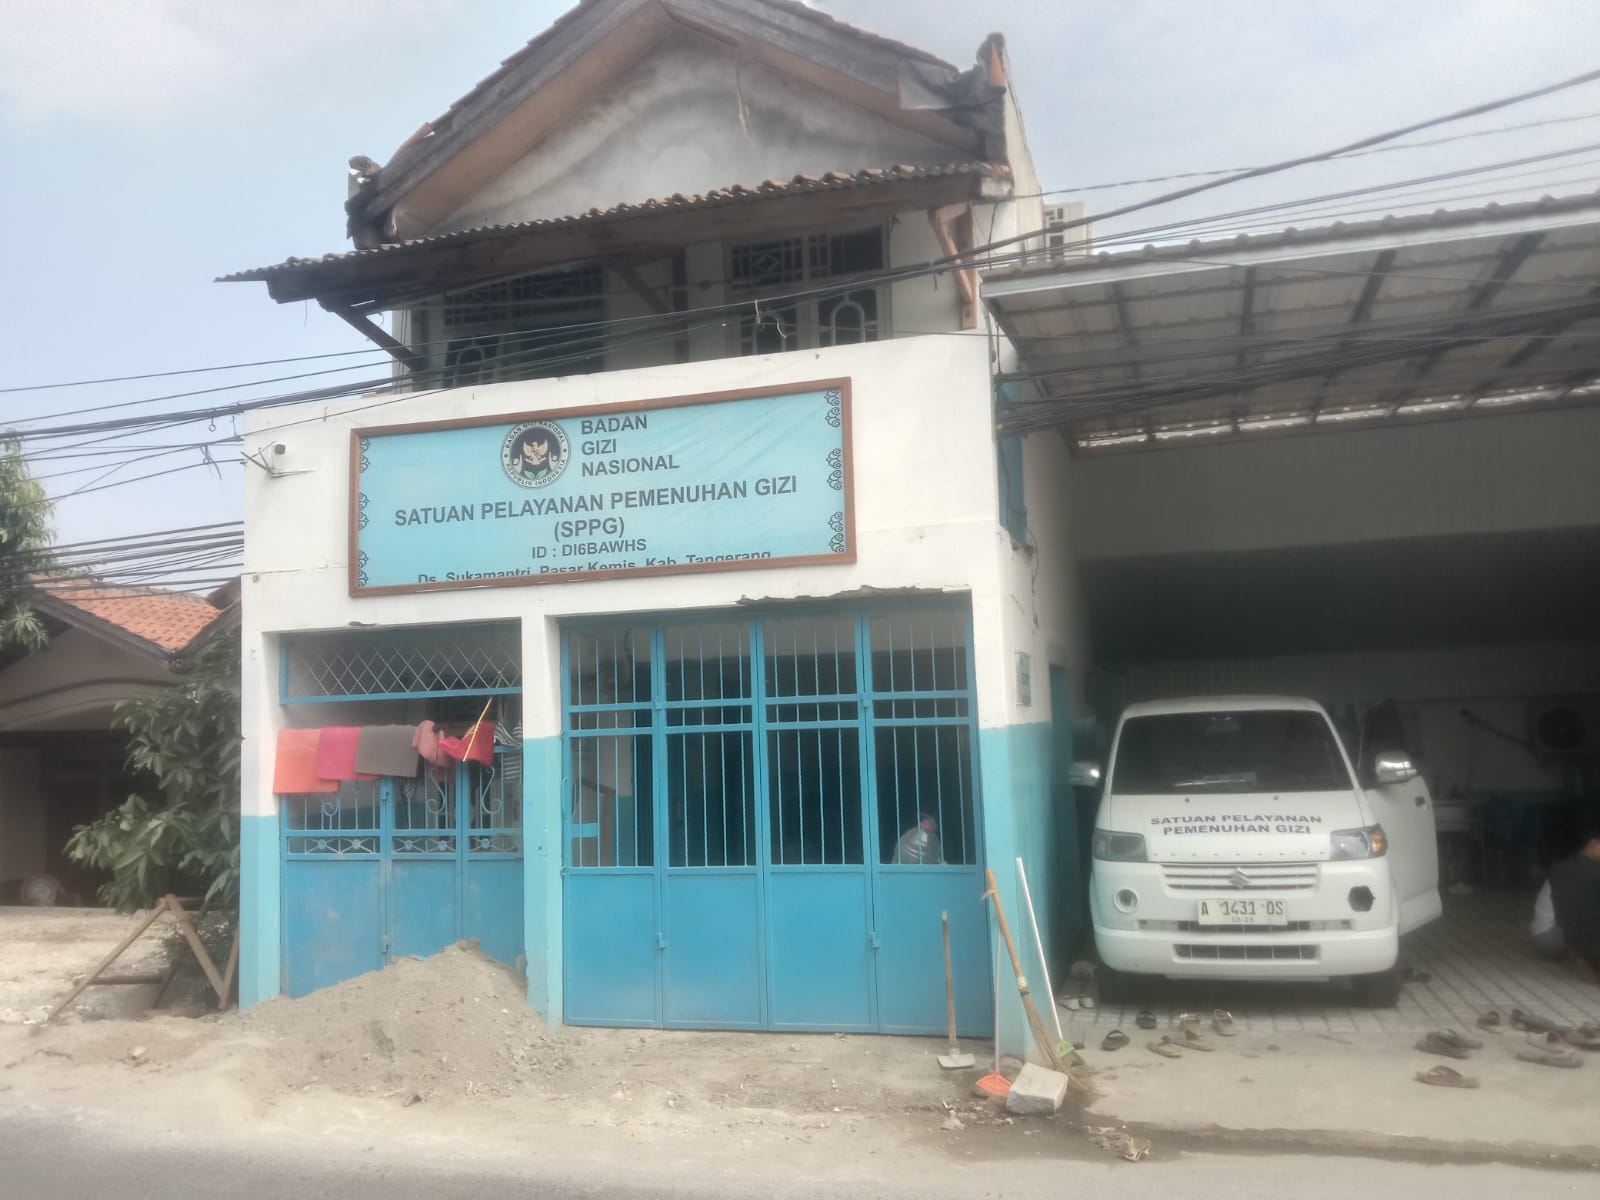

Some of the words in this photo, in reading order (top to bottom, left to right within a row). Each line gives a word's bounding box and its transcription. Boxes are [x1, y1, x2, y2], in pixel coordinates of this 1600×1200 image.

[581, 414, 648, 435] BADAN
[581, 438, 617, 456] GIZI
[581, 454, 680, 477] NASIONAL
[394, 504, 475, 527] SATUAN
[480, 492, 604, 520] PELAYANAN
[610, 480, 748, 510] PEMENUHAN
[754, 475, 798, 496] GIZI
[553, 516, 625, 542] (SPPG)
[531, 545, 548, 559] ID
[1150, 815, 1216, 825] SATUAN
[1221, 814, 1322, 823] PELAYANAN
[1163, 824, 1270, 836] PEMENUHAN
[1275, 824, 1311, 835] GIZI
[1201, 901, 1209, 916] A
[1220, 900, 1256, 916] 1431
